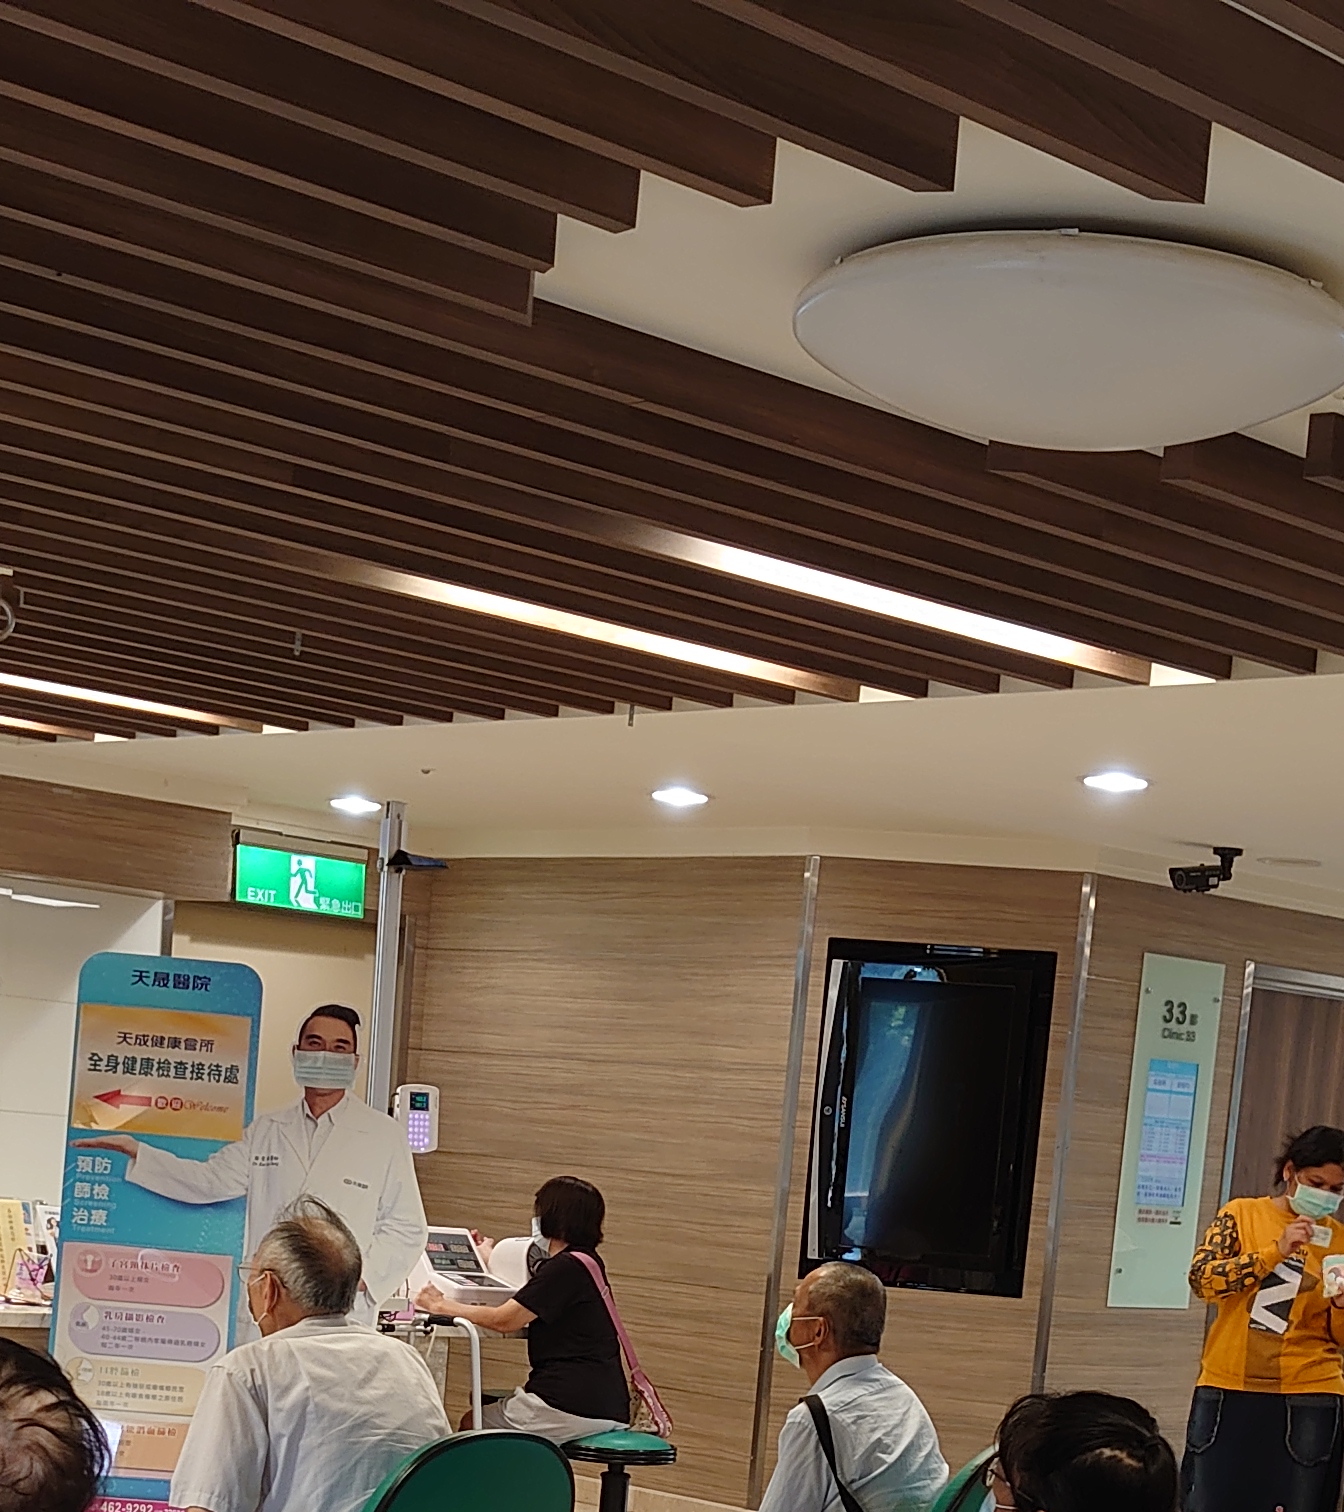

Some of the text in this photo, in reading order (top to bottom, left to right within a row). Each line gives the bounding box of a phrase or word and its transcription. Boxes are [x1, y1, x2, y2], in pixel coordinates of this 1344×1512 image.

[246, 886, 277, 903] EXIT
[319, 896, 362, 914] 緊急出口
[130, 968, 212, 992] 天晟醫院
[116, 1030, 215, 1053] 天成健康會所
[87, 1052, 240, 1085] 全身健康檢查接待處
[76, 1156, 112, 1174] 預防
[72, 1207, 108, 1227] 治療
